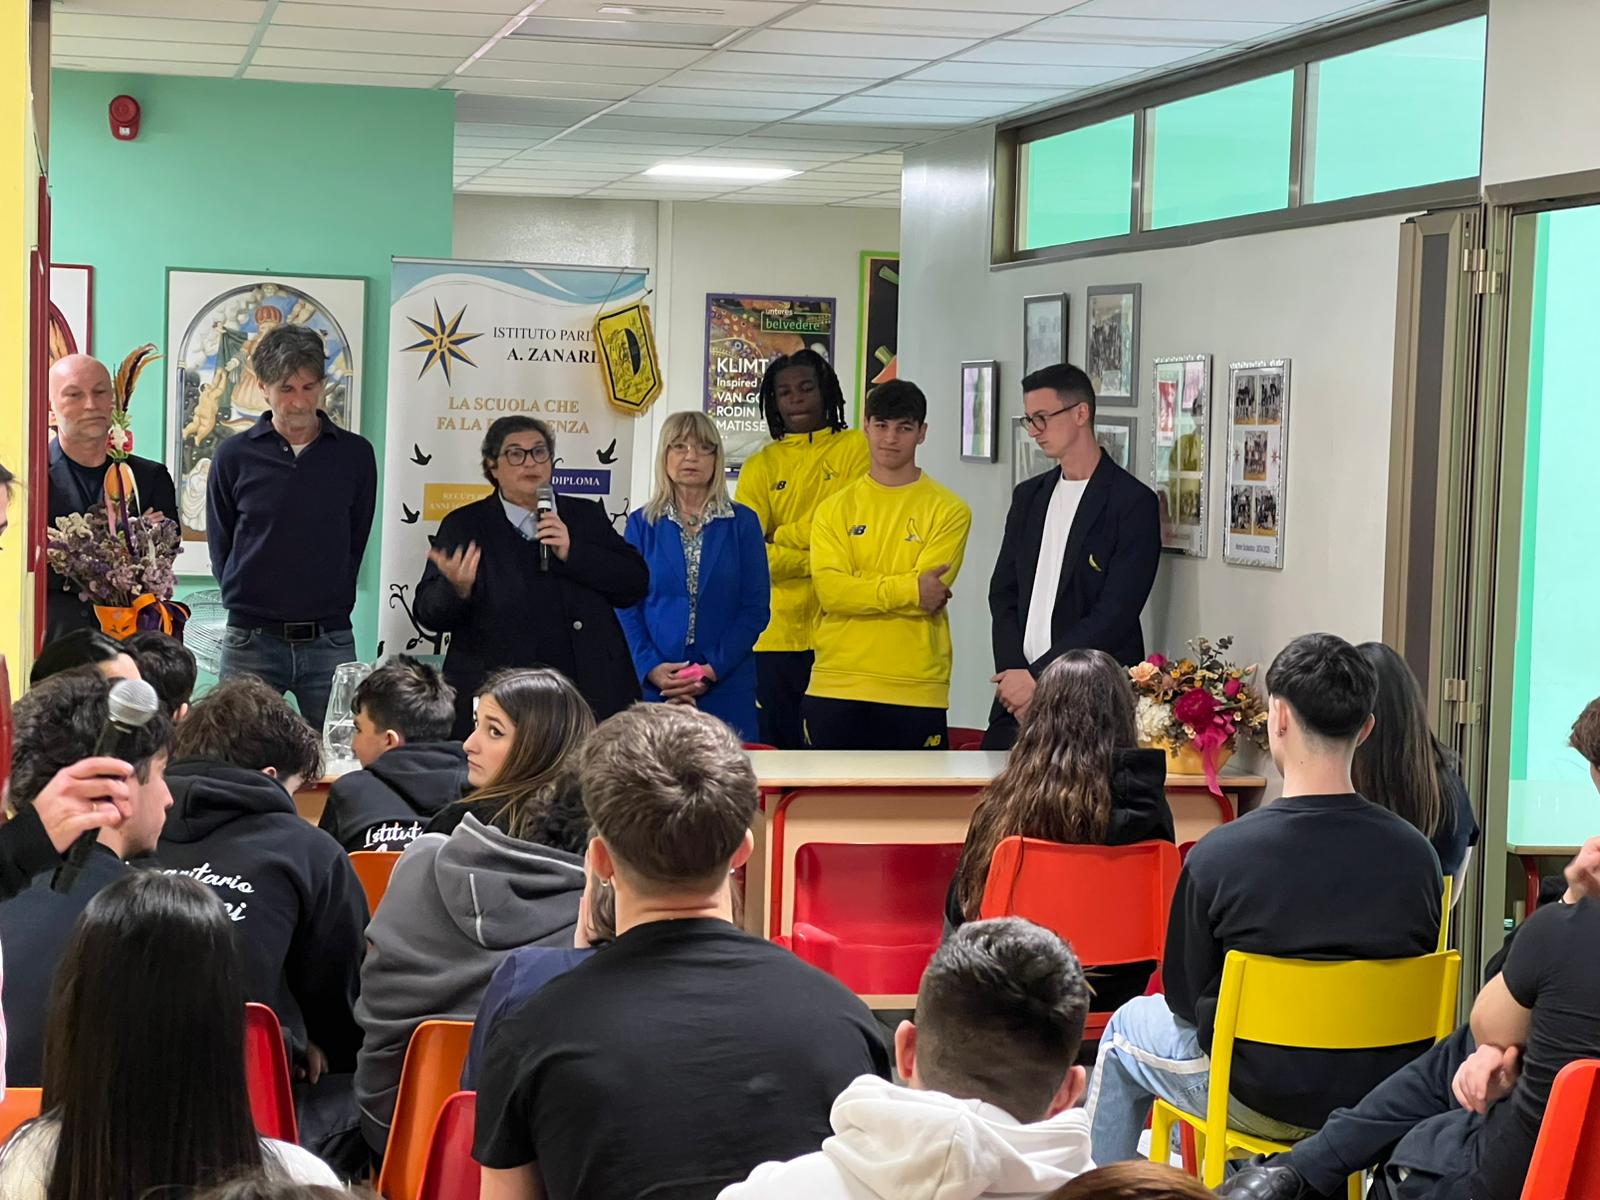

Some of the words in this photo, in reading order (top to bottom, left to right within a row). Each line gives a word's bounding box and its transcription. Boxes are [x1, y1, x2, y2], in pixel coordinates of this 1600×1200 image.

[765, 308, 794, 316] unteres
[765, 318, 820, 331] belvedere
[493, 326, 556, 341] ISTITUTO
[559, 329, 594, 343] PARI
[506, 347, 524, 362] A.
[717, 357, 769, 374] KLIMT
[716, 377, 758, 390] Inspired
[717, 392, 742, 403] VAN
[447, 396, 471, 411] LA
[473, 397, 541, 413] SCUOLA
[544, 399, 580, 414] CHE
[716, 406, 755, 418] RODIN
[436, 416, 456, 431] FA
[459, 417, 482, 432] LA
[716, 420, 766, 432] MATISSE
[551, 475, 601, 487] DIPLOMA
